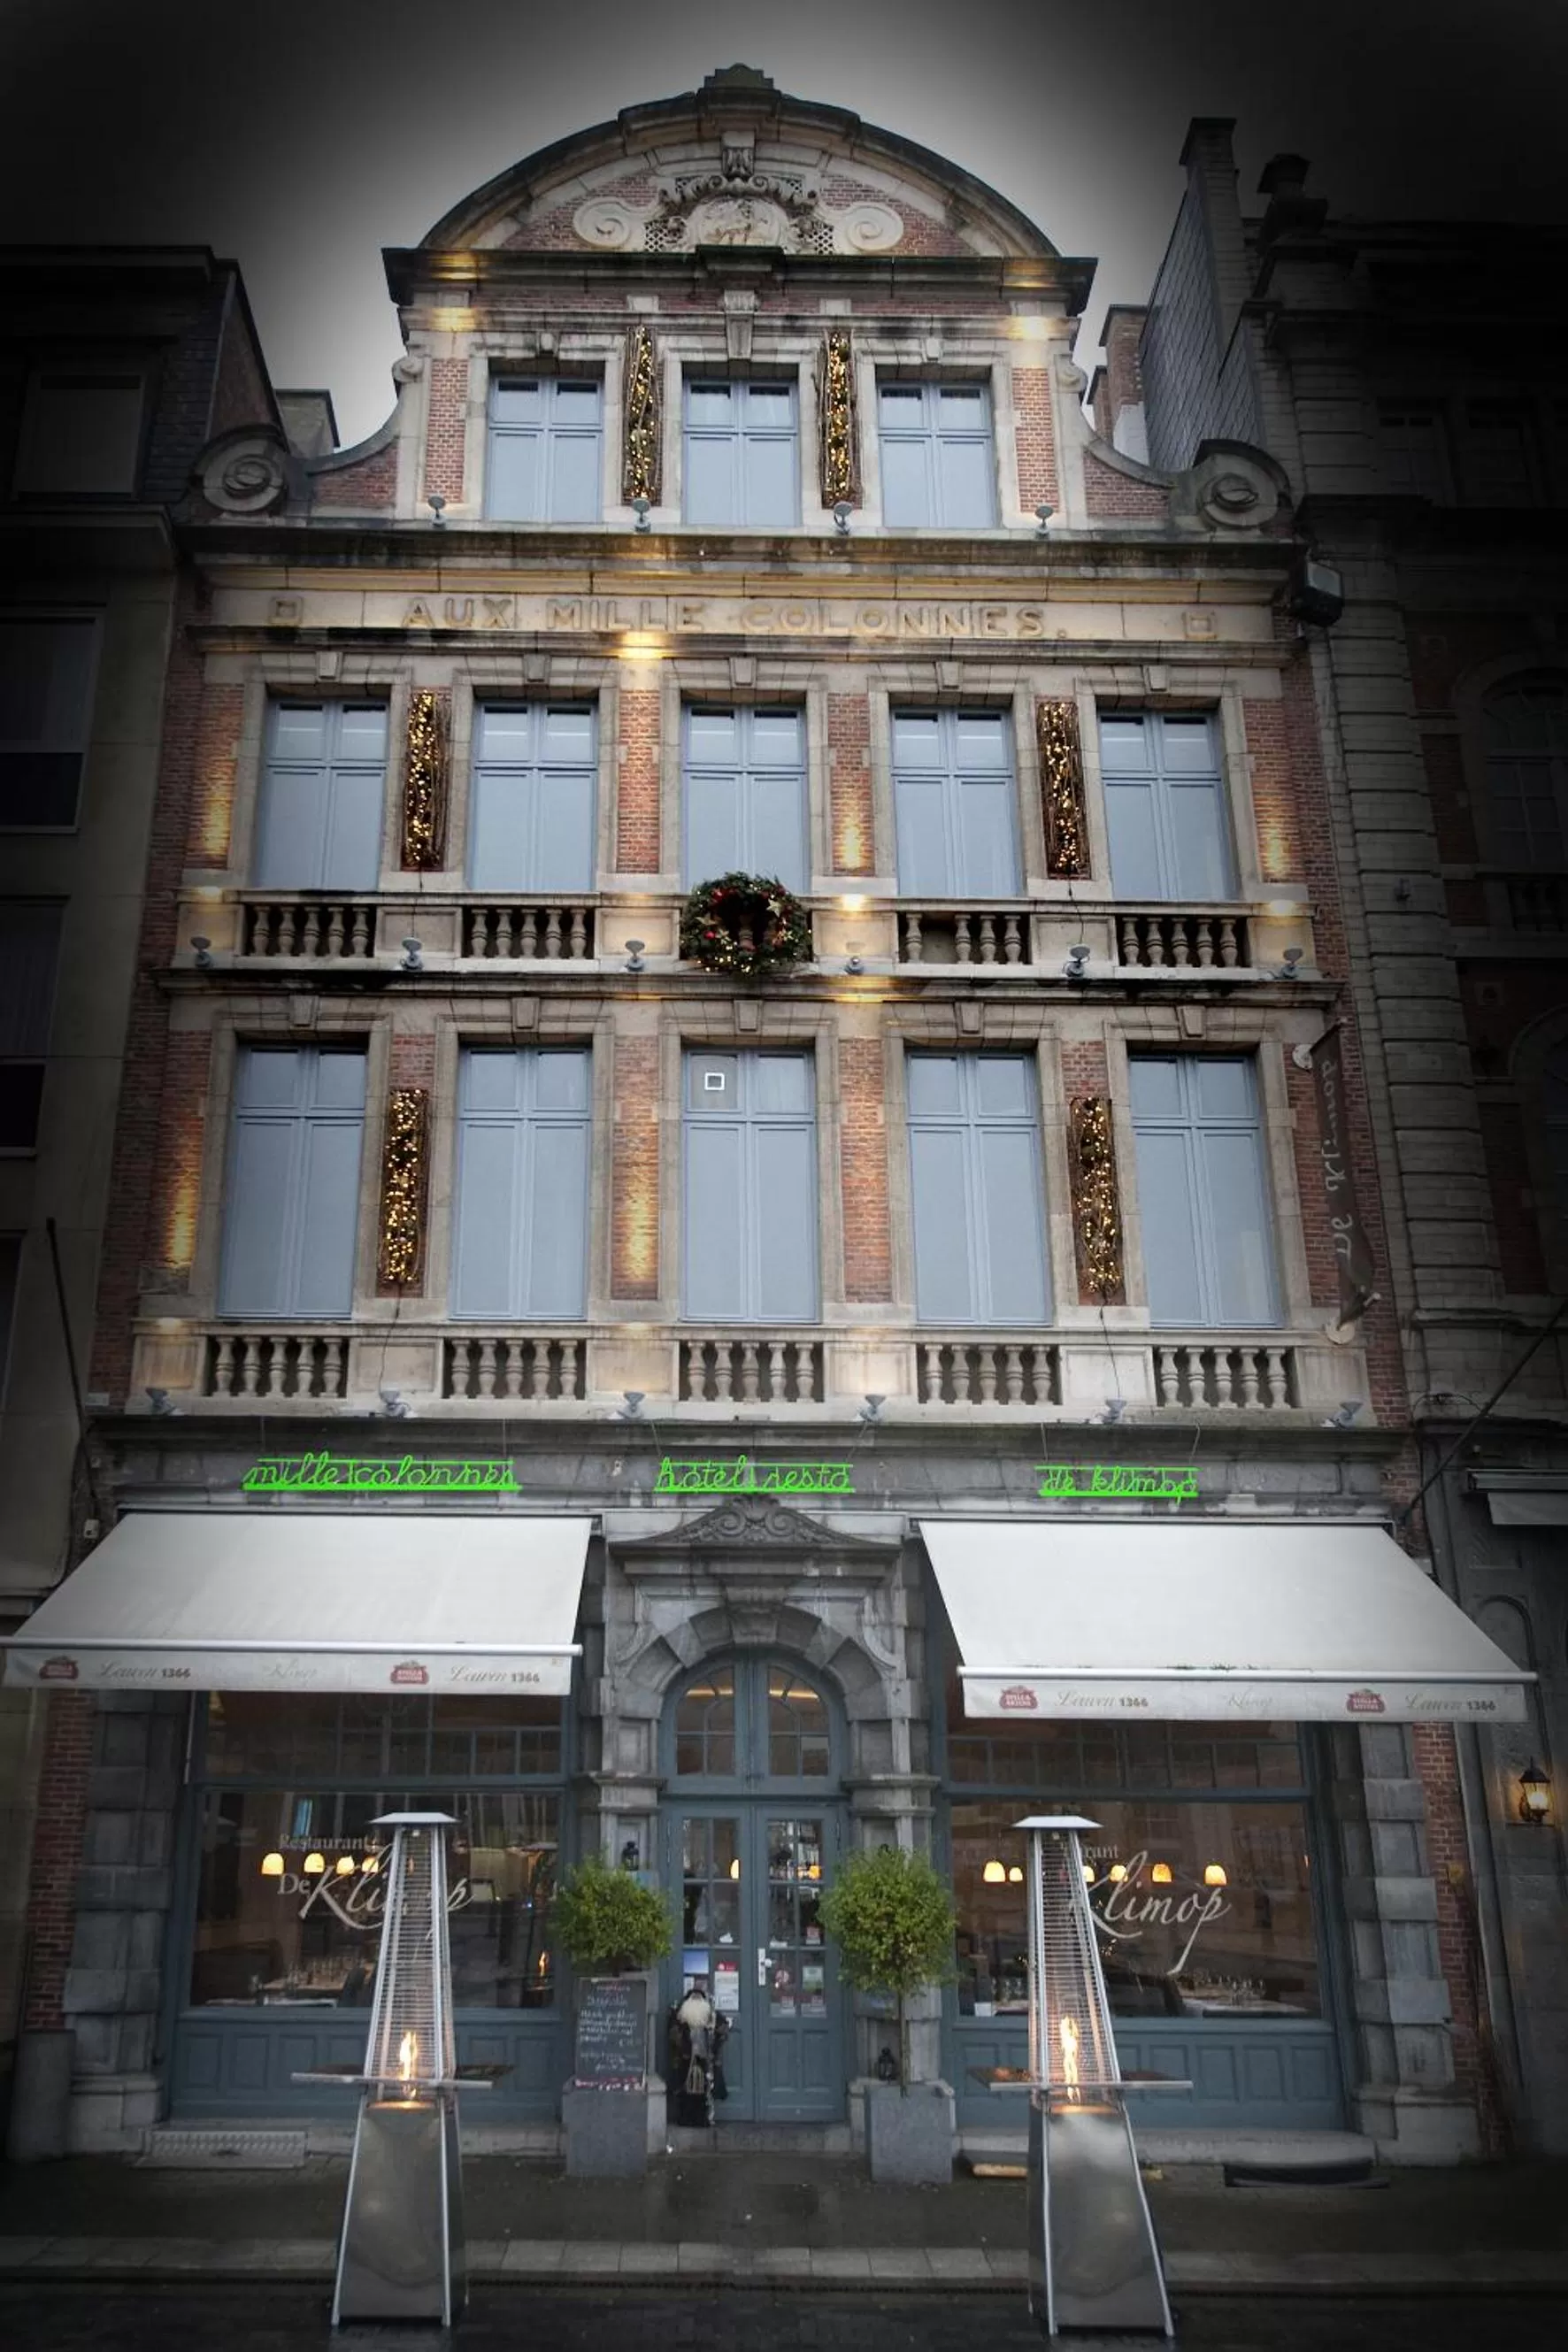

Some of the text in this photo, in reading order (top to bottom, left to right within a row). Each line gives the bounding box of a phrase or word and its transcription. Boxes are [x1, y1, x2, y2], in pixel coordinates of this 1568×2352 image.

[401, 596, 513, 630] AUX
[545, 596, 705, 632] MILLE
[242, 1451, 339, 1487] mille
[656, 1455, 750, 1490] hotel
[1041, 1467, 1076, 1493] de
[161, 1667, 192, 1679] 1366
[1118, 1696, 1149, 1708] 1366
[1466, 1699, 1497, 1711] 1366
[278, 1833, 367, 1851] Restaurant
[276, 1842, 475, 1963] De Klip
